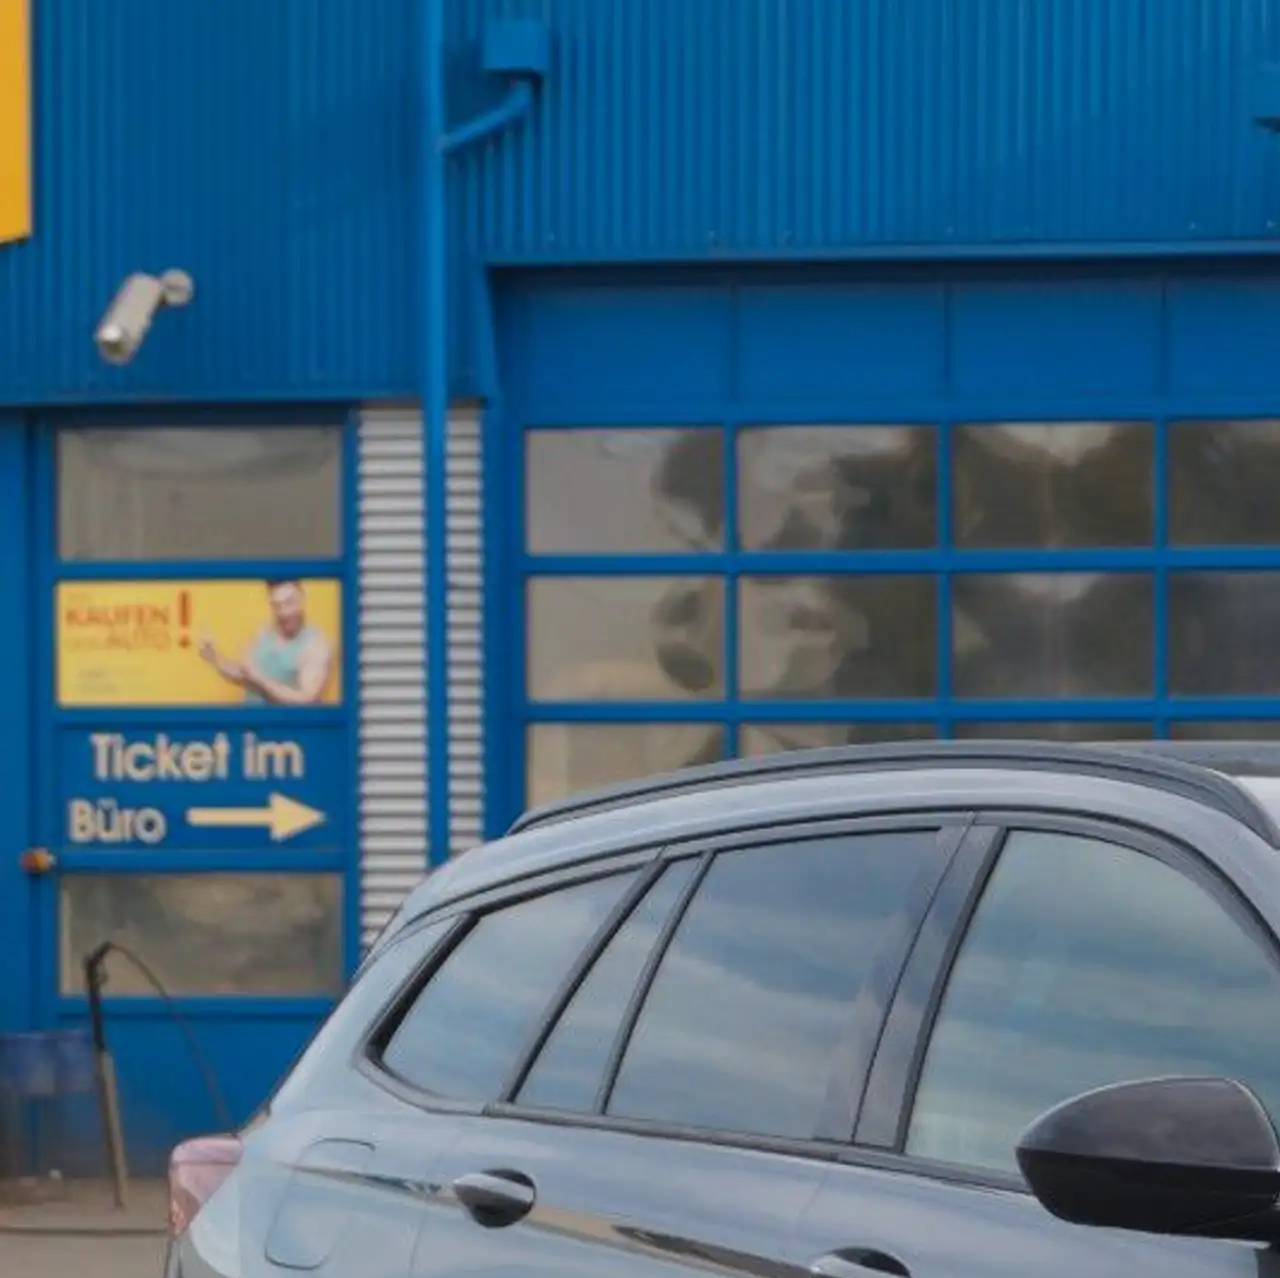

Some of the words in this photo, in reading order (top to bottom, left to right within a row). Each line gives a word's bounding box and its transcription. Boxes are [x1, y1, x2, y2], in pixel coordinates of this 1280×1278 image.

[90, 732, 230, 782] Ticket
[244, 731, 304, 781] im
[69, 798, 167, 843] Büro
